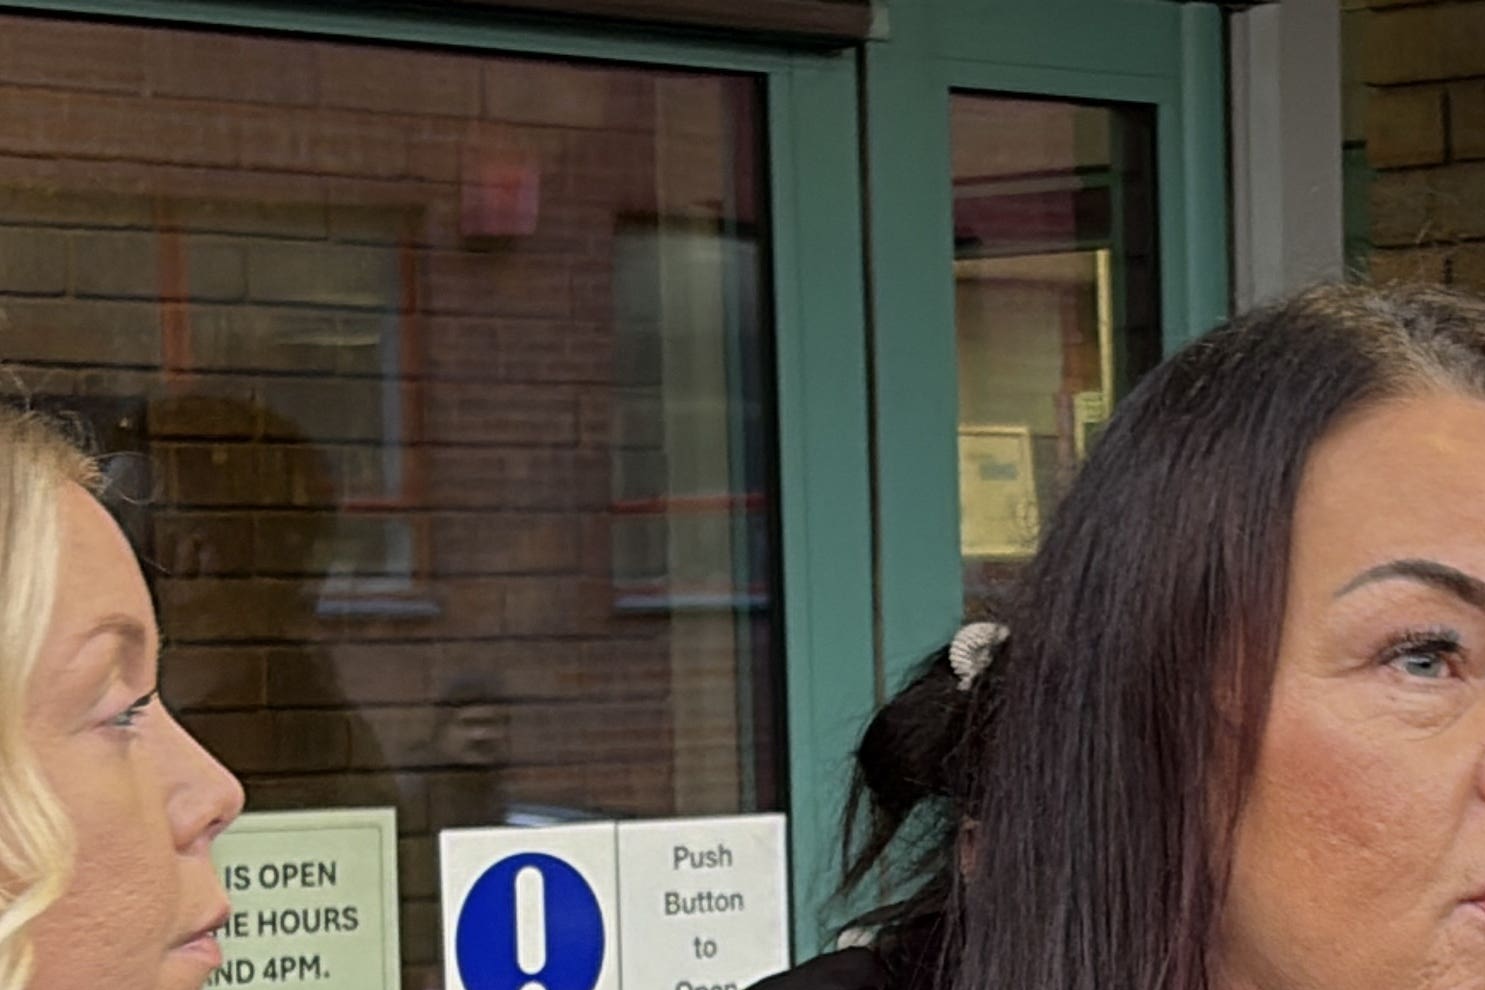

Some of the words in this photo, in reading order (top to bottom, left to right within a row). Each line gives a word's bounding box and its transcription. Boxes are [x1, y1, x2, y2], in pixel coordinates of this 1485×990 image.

[673, 843, 733, 870] Push
[224, 865, 251, 891] IS
[258, 860, 338, 889] OPEN
[664, 890, 745, 916] Button
[257, 906, 359, 936] HOURS
[693, 935, 718, 959] to
[206, 958, 256, 987] ND
[262, 955, 331, 982] 4PM.
